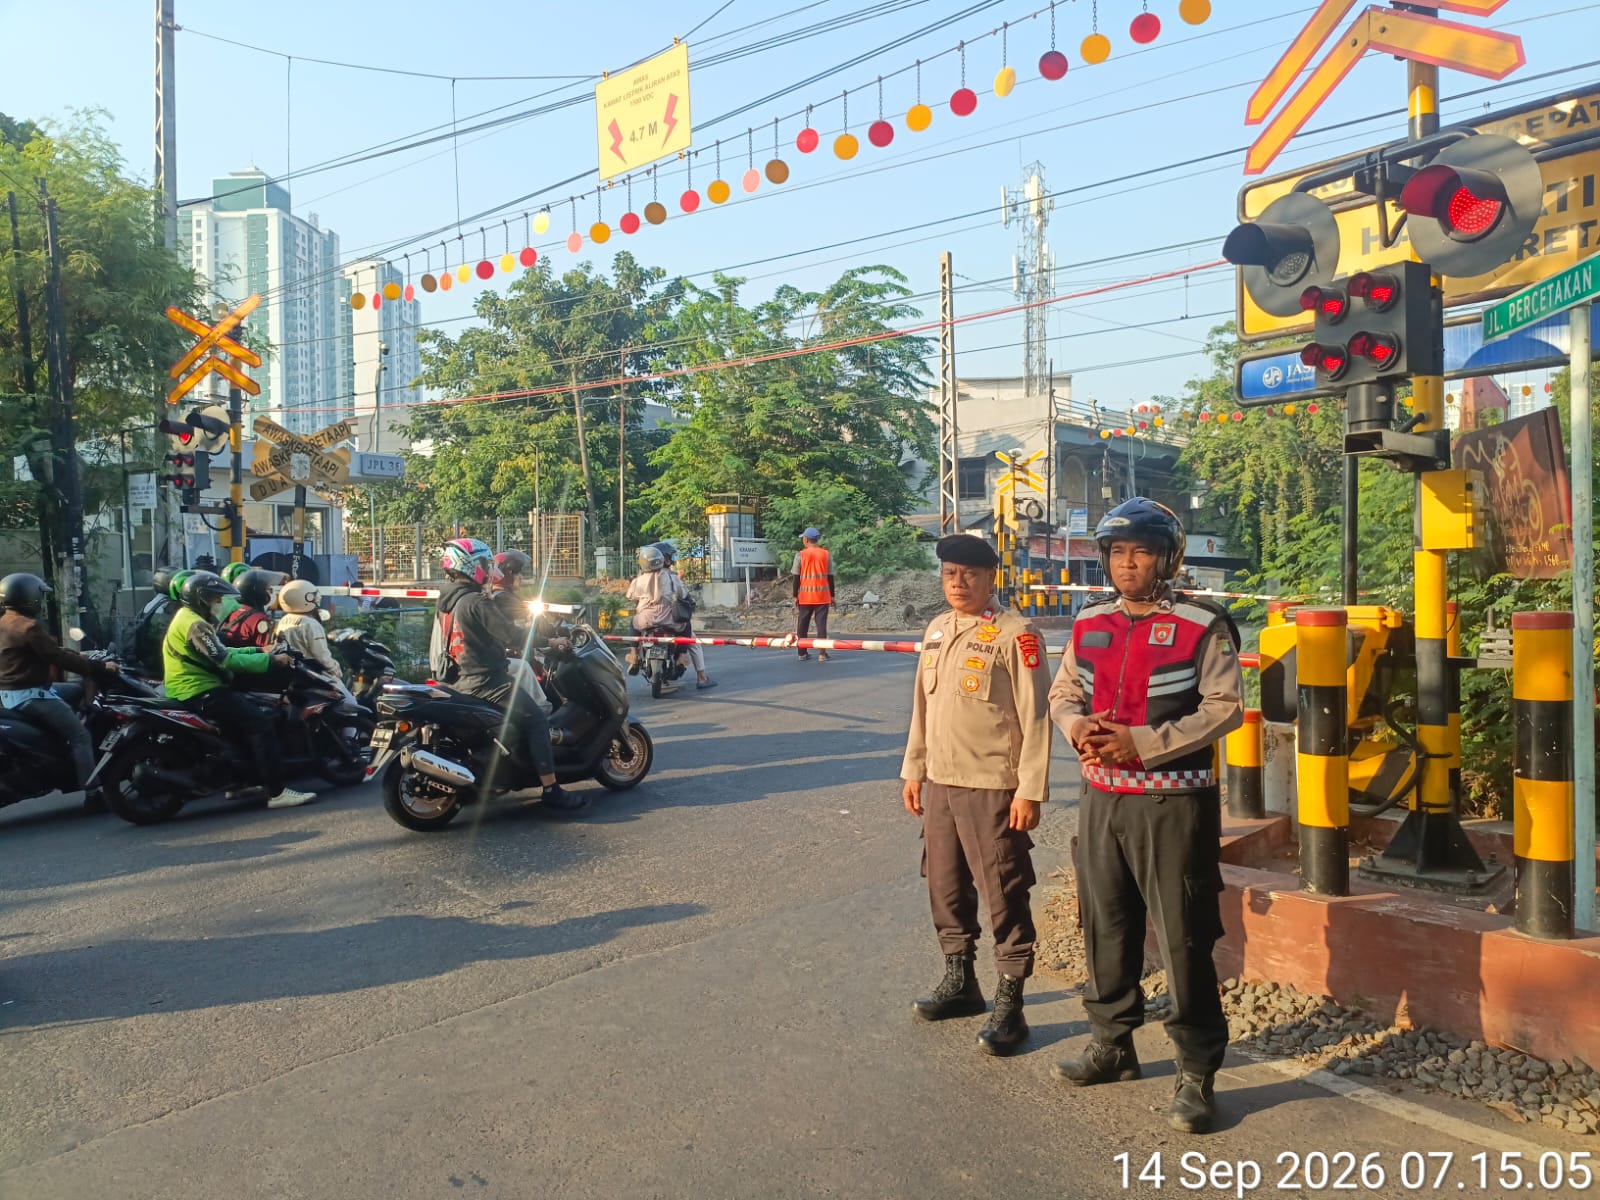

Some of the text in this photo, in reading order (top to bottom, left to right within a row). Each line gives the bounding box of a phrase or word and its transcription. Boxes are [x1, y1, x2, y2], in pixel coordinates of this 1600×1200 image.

[629, 121, 658, 143] 4.7 M
[1487, 265, 1592, 335] JL. PERCETAKAN
[367, 459, 385, 471] JPL
[966, 641, 995, 654] POLRI
